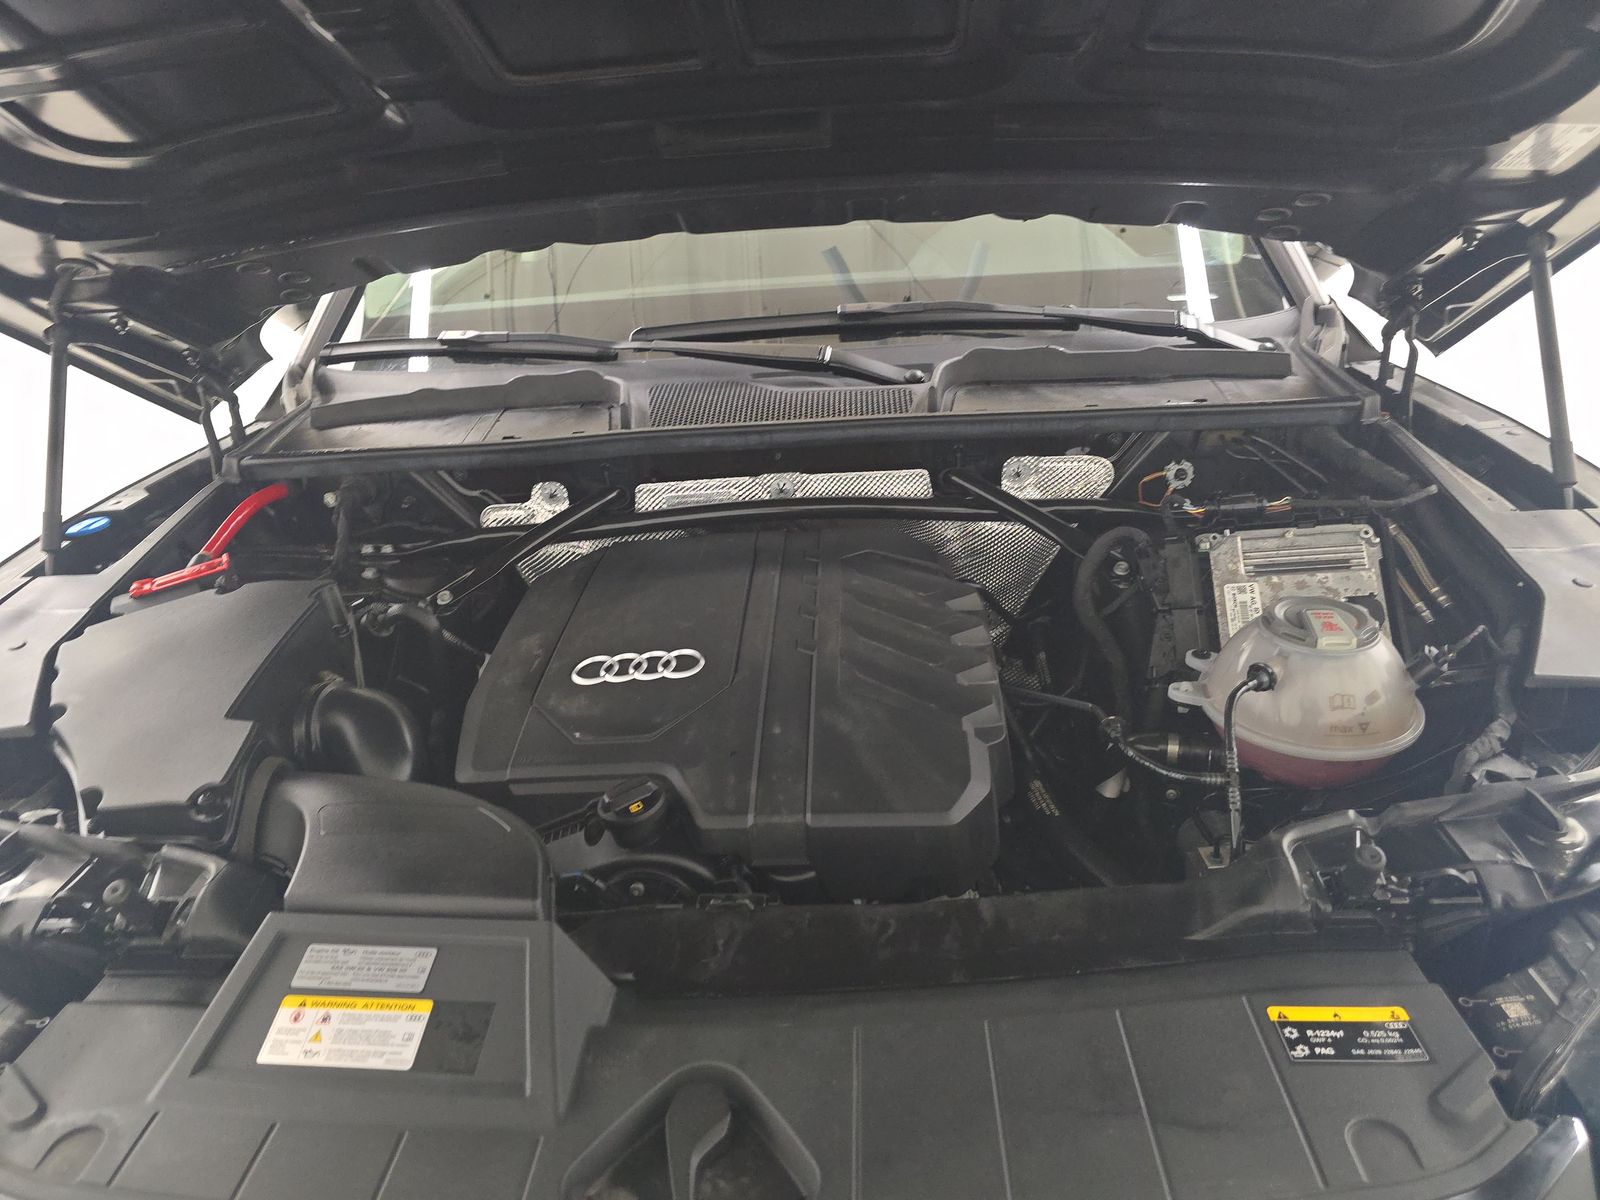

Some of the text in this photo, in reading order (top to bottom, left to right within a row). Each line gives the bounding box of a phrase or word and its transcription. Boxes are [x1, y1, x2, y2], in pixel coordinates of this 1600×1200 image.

[1329, 724, 1354, 734] max
[310, 999, 416, 1011] WARNING ATTENTION
[1314, 1046, 1336, 1056] PAG
